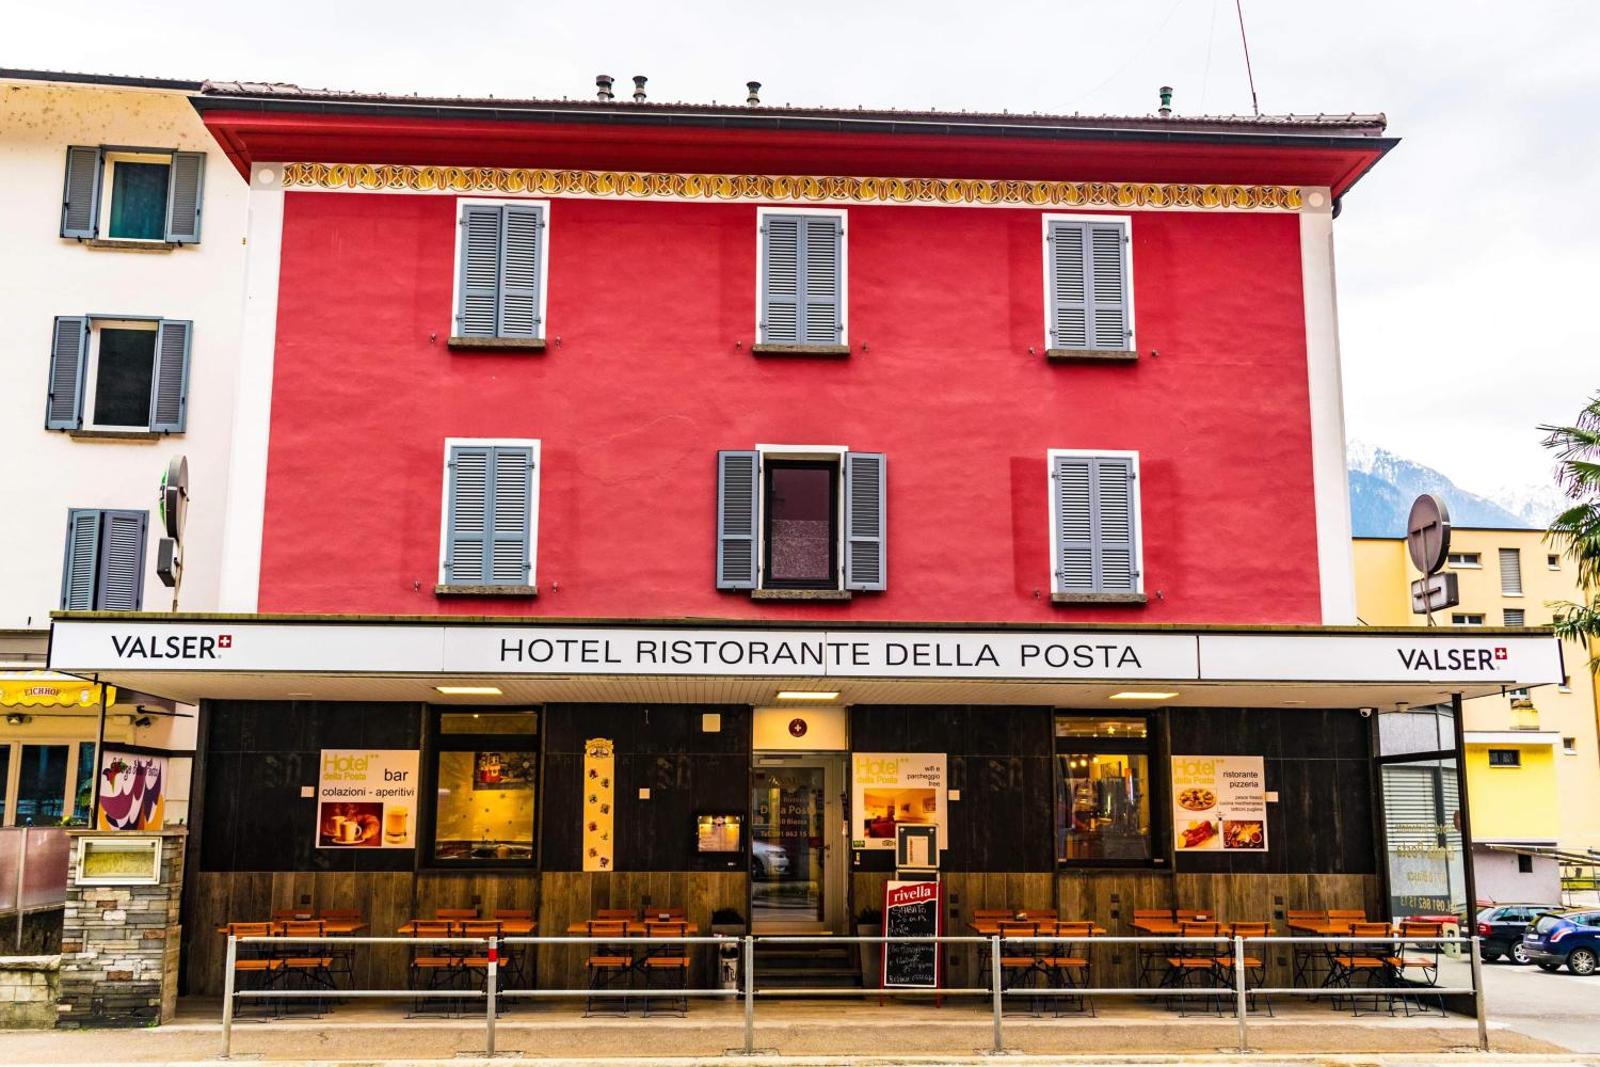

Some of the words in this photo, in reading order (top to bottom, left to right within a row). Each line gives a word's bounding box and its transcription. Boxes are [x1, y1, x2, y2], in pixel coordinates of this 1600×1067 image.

[112, 635, 216, 659] VALSER
[501, 638, 622, 663] HOTEL
[637, 640, 869, 666] RISTORANTE
[887, 643, 1000, 667] DELLA
[1022, 644, 1142, 669] POSTA
[1398, 648, 1494, 671] VALSER
[323, 753, 369, 771] Hotel
[856, 757, 898, 775] Hotel
[1174, 758, 1215, 775] Hotel
[344, 772, 367, 780] Posta
[384, 768, 409, 782] bar
[907, 773, 941, 781] parcheggio
[1222, 769, 1259, 779] ristorante
[321, 787, 366, 797] colazioni
[375, 787, 415, 798] aperitivi
[1229, 780, 1259, 788] pizzeria
[894, 885, 931, 902] rivella
